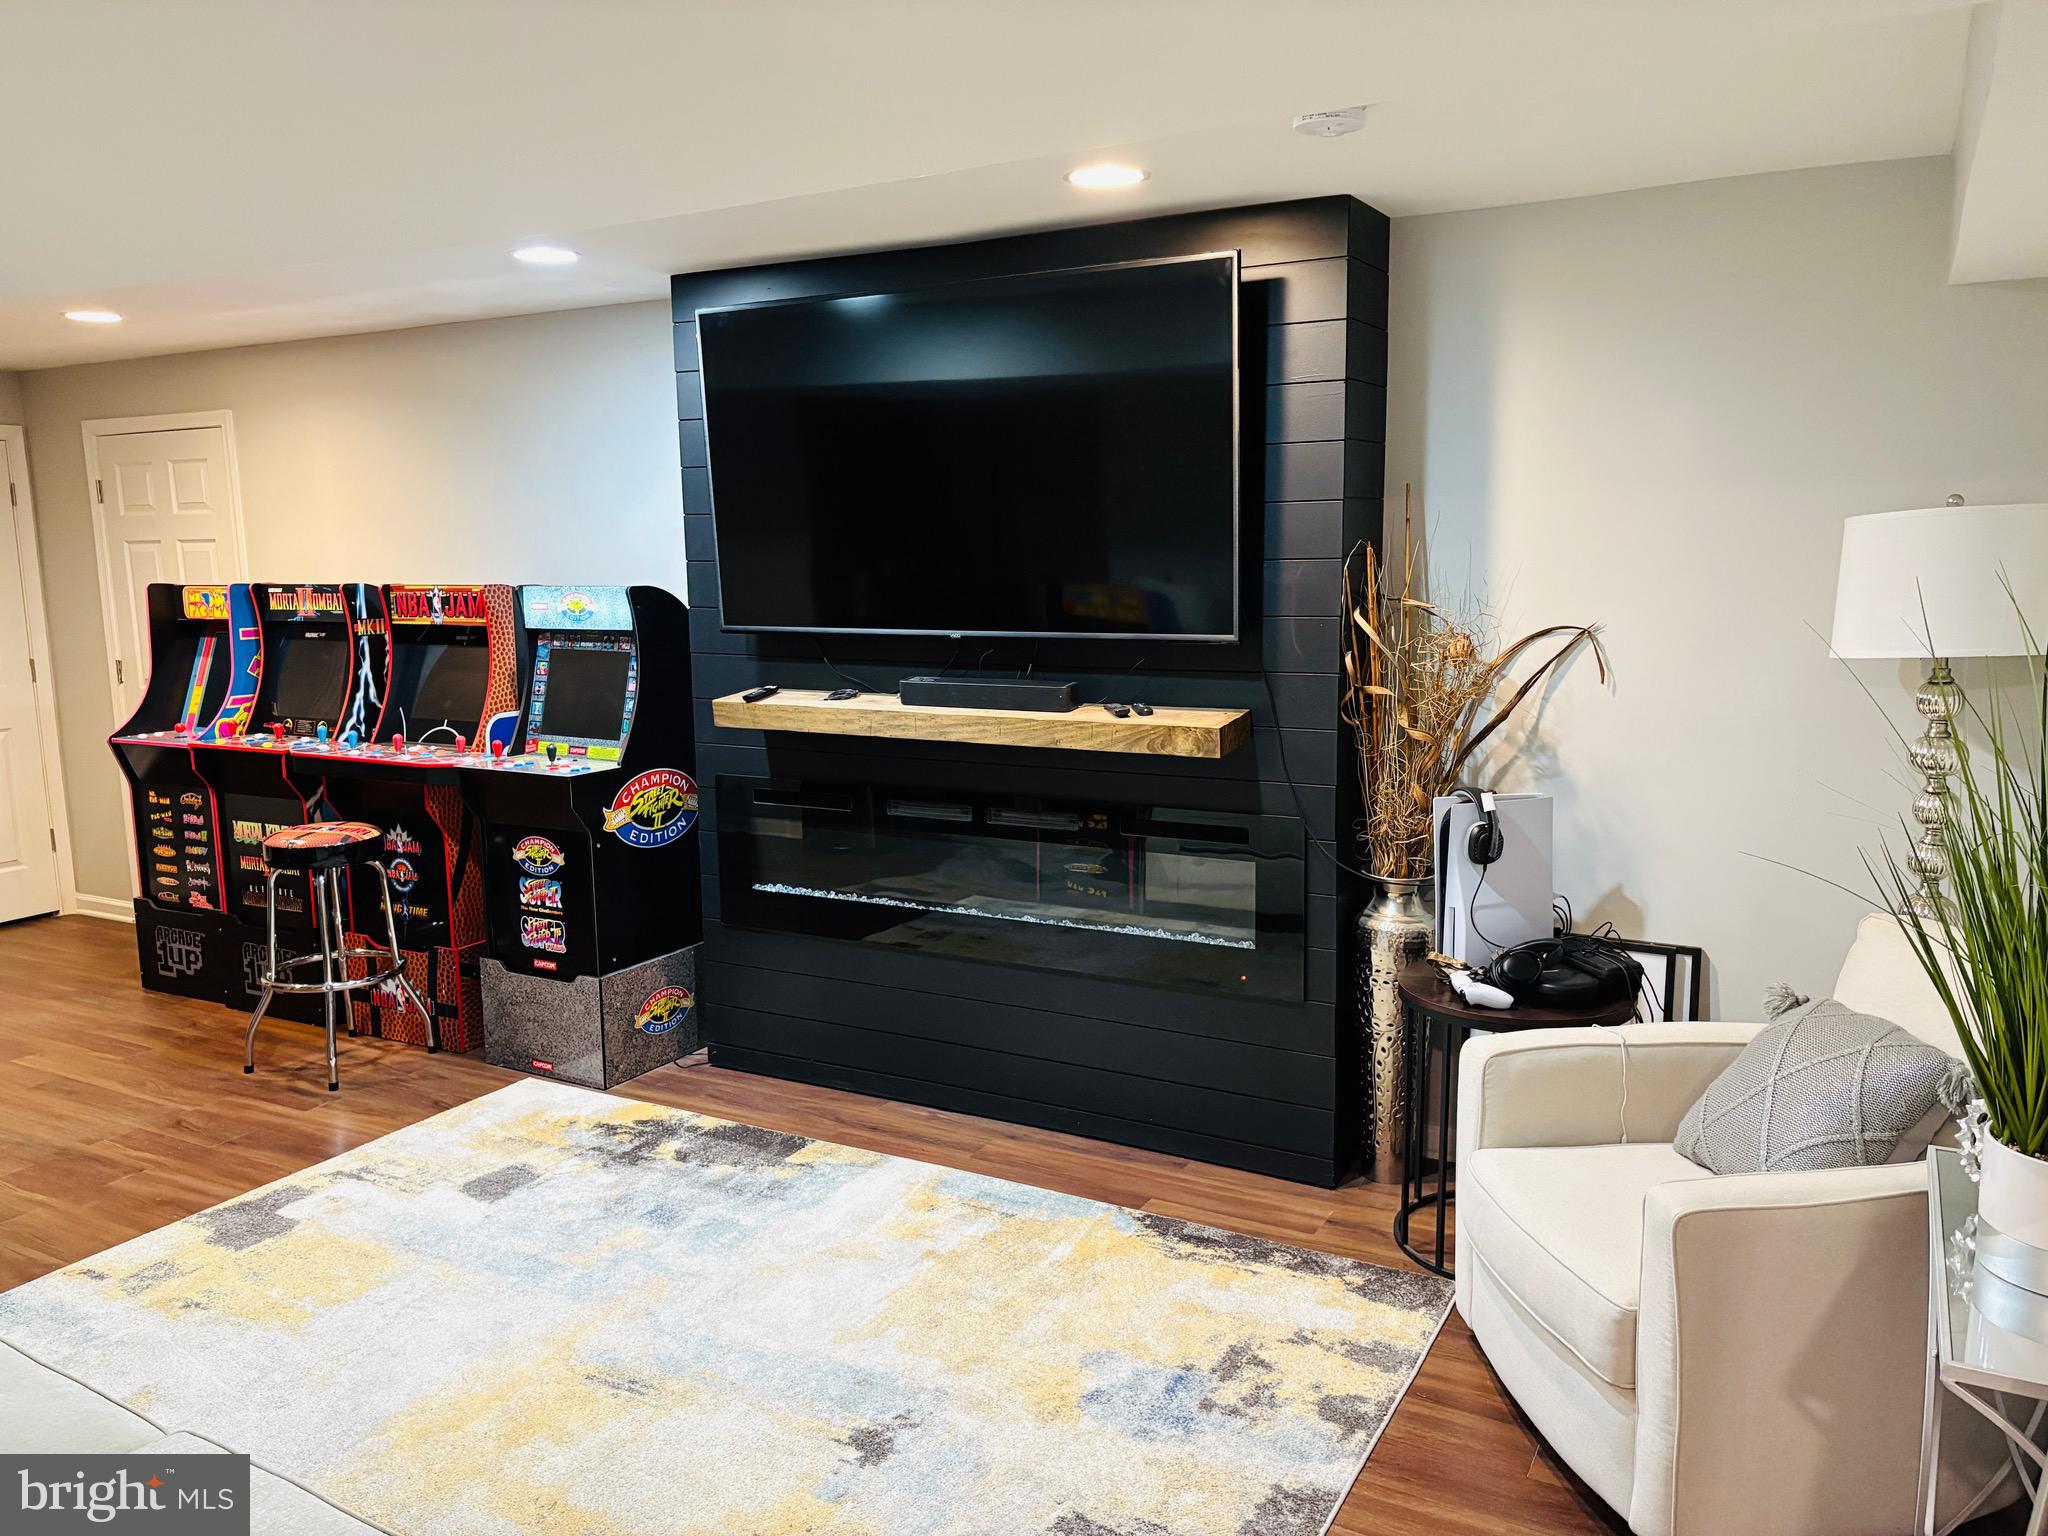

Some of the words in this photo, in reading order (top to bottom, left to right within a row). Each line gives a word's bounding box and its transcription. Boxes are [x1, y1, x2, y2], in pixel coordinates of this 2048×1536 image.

[396, 592, 431, 618] NBA
[445, 592, 486, 618] JAM
[622, 774, 689, 803] CHAMPION
[637, 788, 683, 818] FIGHTER
[652, 811, 667, 830] II
[629, 818, 687, 844] EDITION
[521, 839, 555, 853] CHAMPION
[525, 862, 554, 874] EDITION
[381, 902, 402, 912] HNG
[409, 906, 428, 916] TIME
[155, 925, 201, 949] ARCADE
[534, 960, 555, 969] CAPCOM
[373, 989, 397, 1009] NBA
[645, 988, 684, 1010] CHAMPION
[650, 1012, 683, 1031] EDITION
